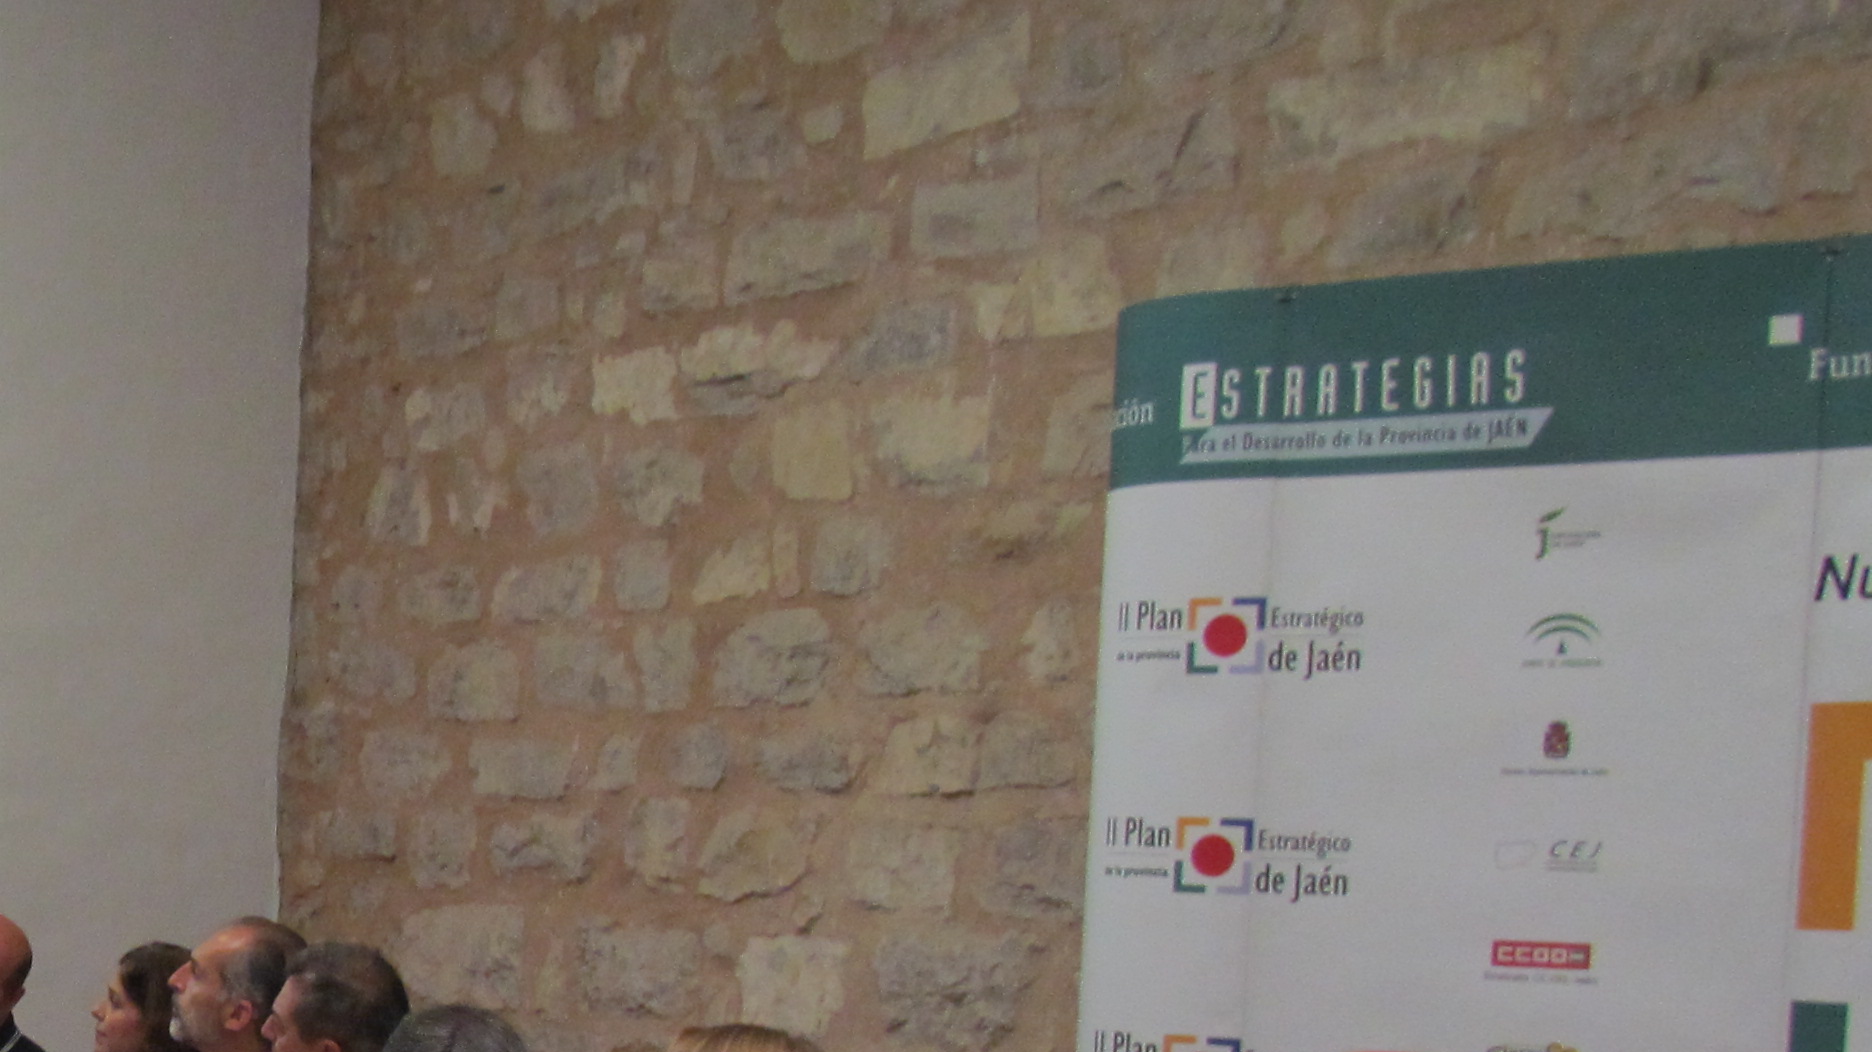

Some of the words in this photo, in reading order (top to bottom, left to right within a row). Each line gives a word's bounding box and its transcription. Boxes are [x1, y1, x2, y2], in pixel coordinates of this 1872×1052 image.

[1183, 349, 1526, 428] ESTRATEGIAS
[1222, 434, 1237, 450] el
[1242, 431, 1326, 451] Desarrollo
[1332, 430, 1351, 448] de
[1358, 428, 1373, 447] la
[1380, 425, 1457, 445] Provincia
[1463, 421, 1482, 441] de
[1136, 600, 1183, 631] Plan
[1270, 606, 1365, 635] Estratégico
[1268, 640, 1298, 673] de
[1302, 639, 1362, 681] Jaén
[1124, 816, 1171, 848] Plan
[1257, 829, 1352, 858] Estratégico
[1255, 863, 1286, 894] de
[1289, 863, 1349, 904] Jaén
